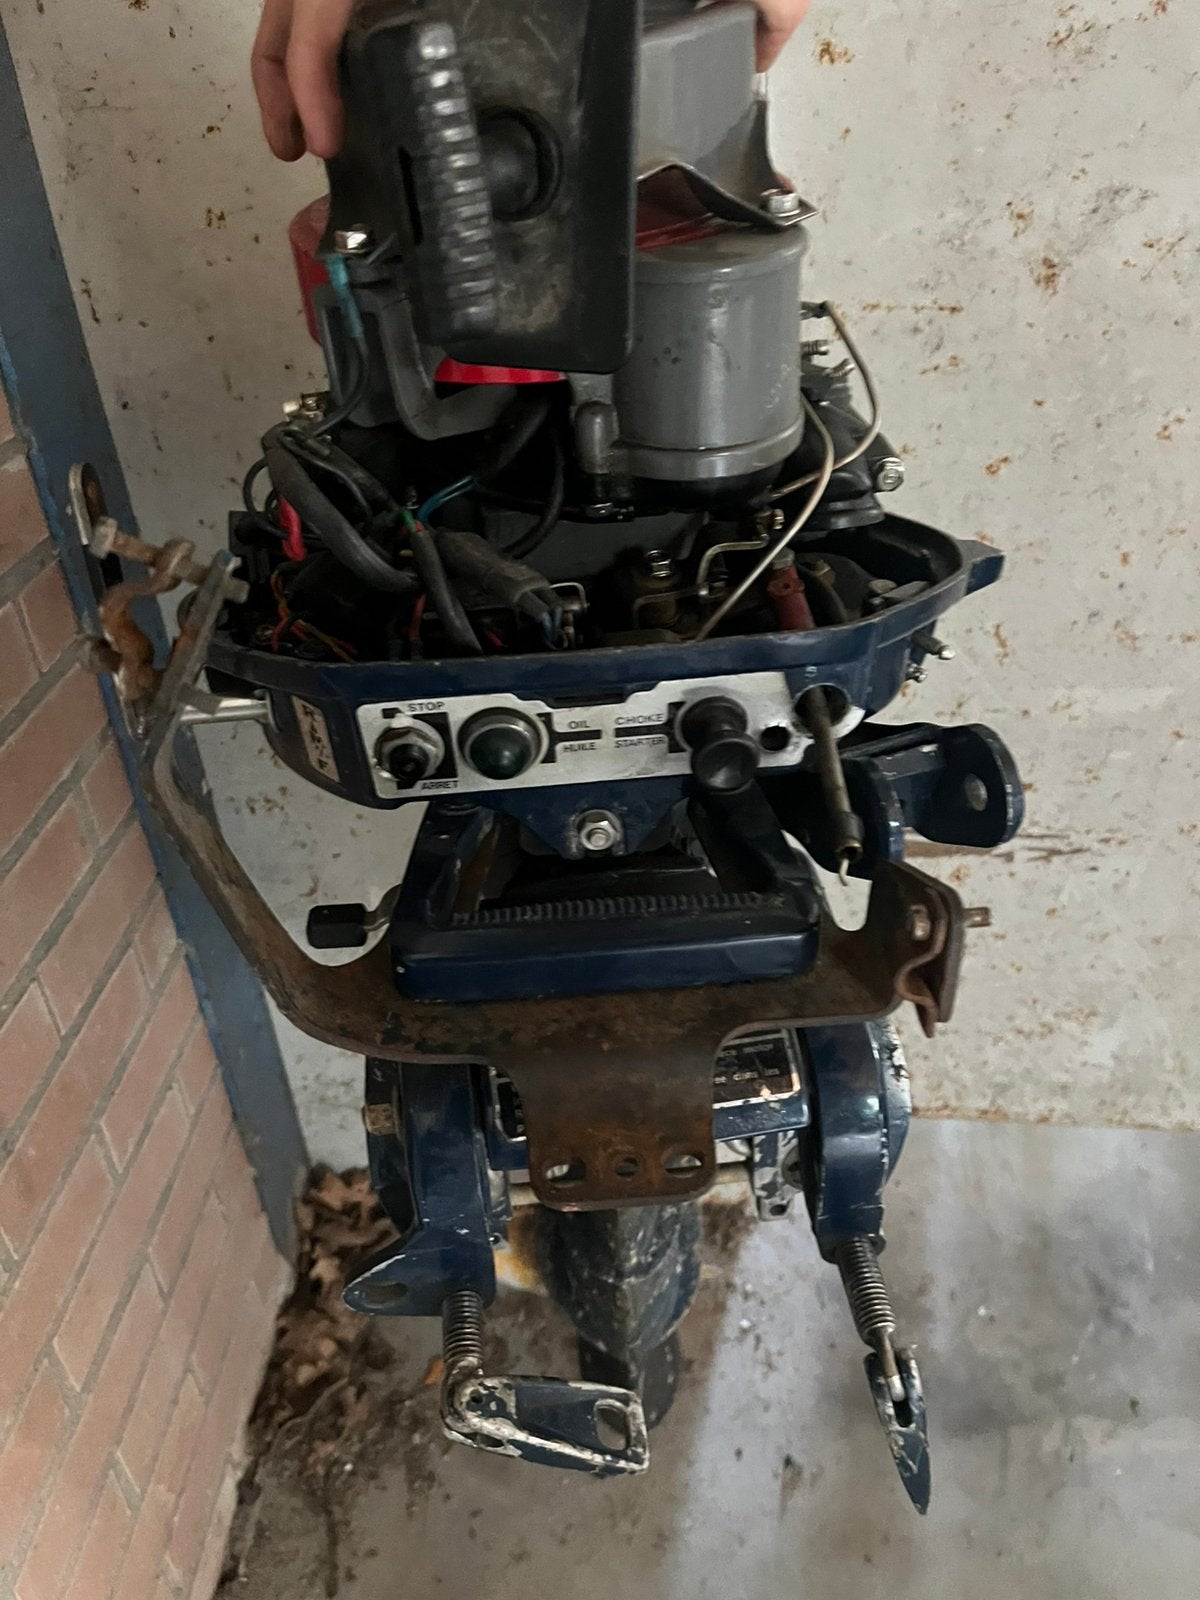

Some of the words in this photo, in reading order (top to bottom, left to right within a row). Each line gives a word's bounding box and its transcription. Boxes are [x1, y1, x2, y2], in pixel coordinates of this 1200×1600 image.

[407, 701, 445, 712] STOP
[567, 720, 590, 729] OIL
[614, 713, 664, 725] CHOKE
[563, 742, 597, 752] HUILE
[614, 736, 666, 748] STARTER
